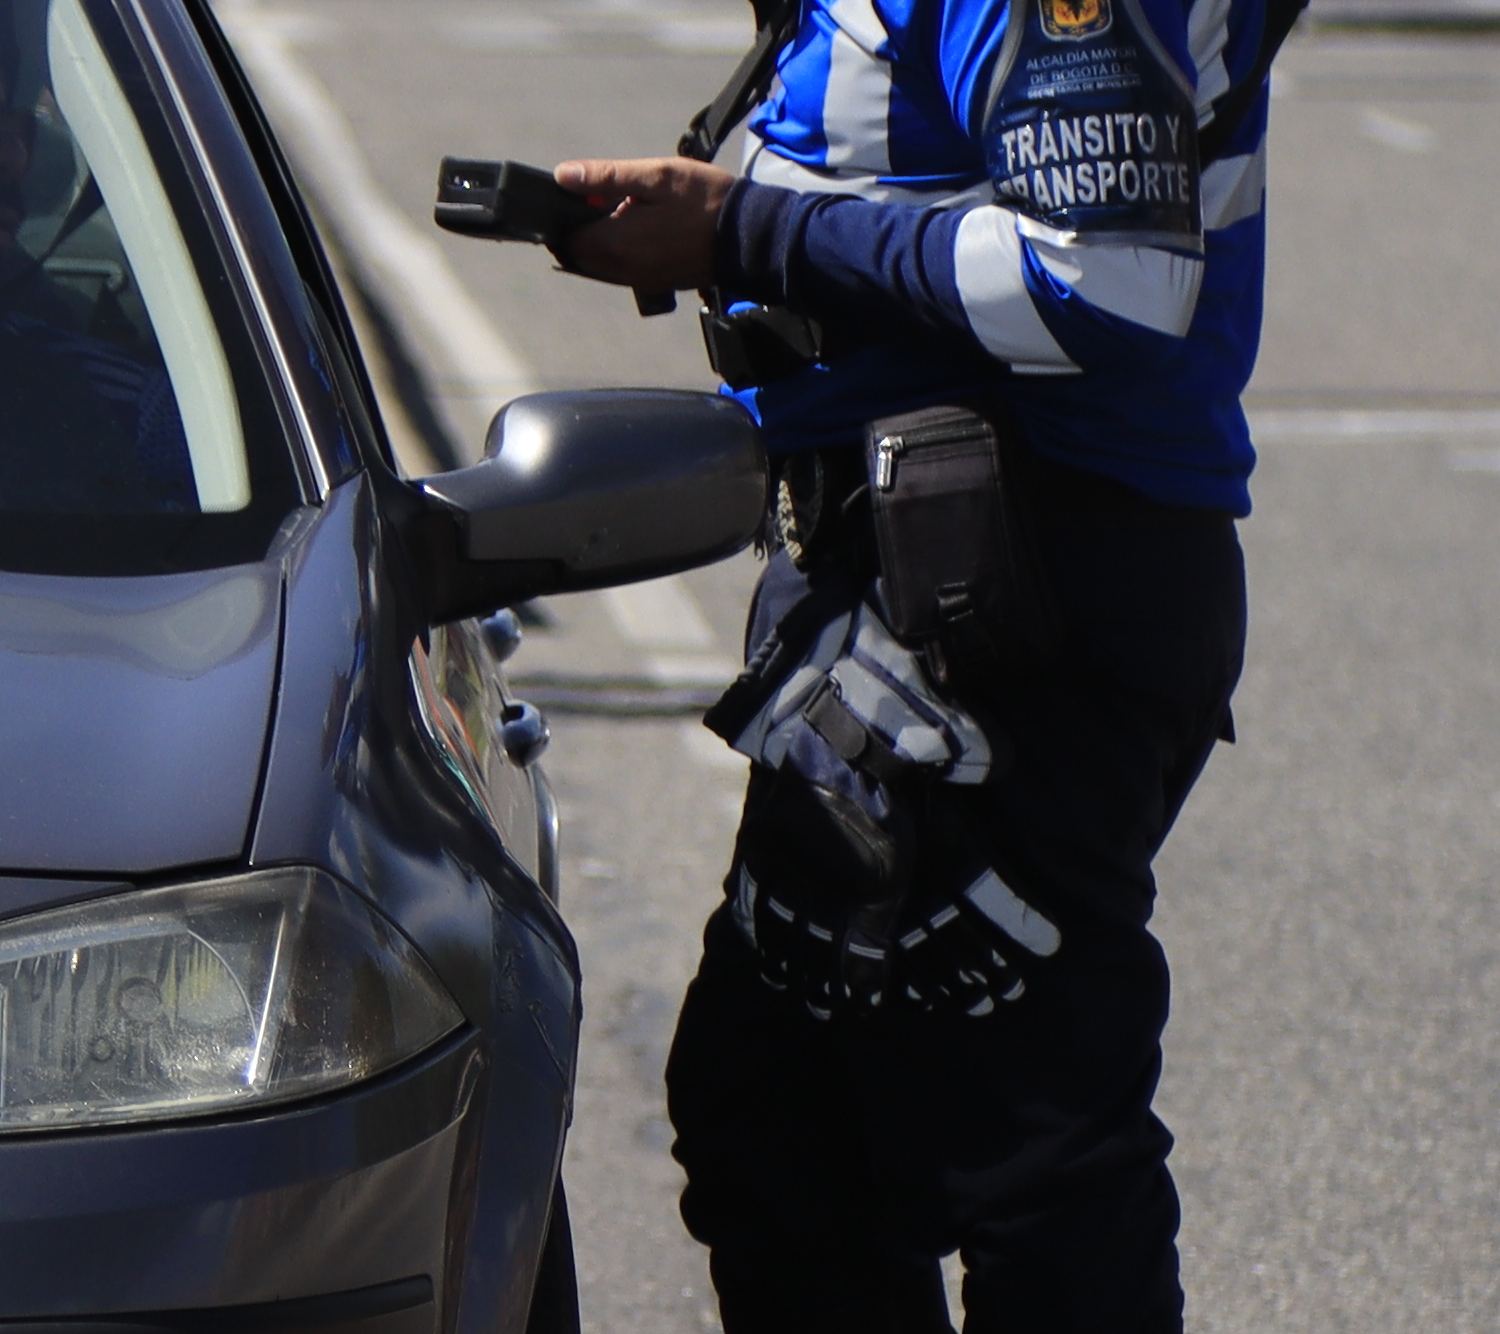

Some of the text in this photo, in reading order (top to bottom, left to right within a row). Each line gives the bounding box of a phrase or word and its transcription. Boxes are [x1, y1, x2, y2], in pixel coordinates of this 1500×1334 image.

[1091, 46, 1137, 61] MAYOR
[1002, 110, 1180, 174] TRÁNSITO Y
